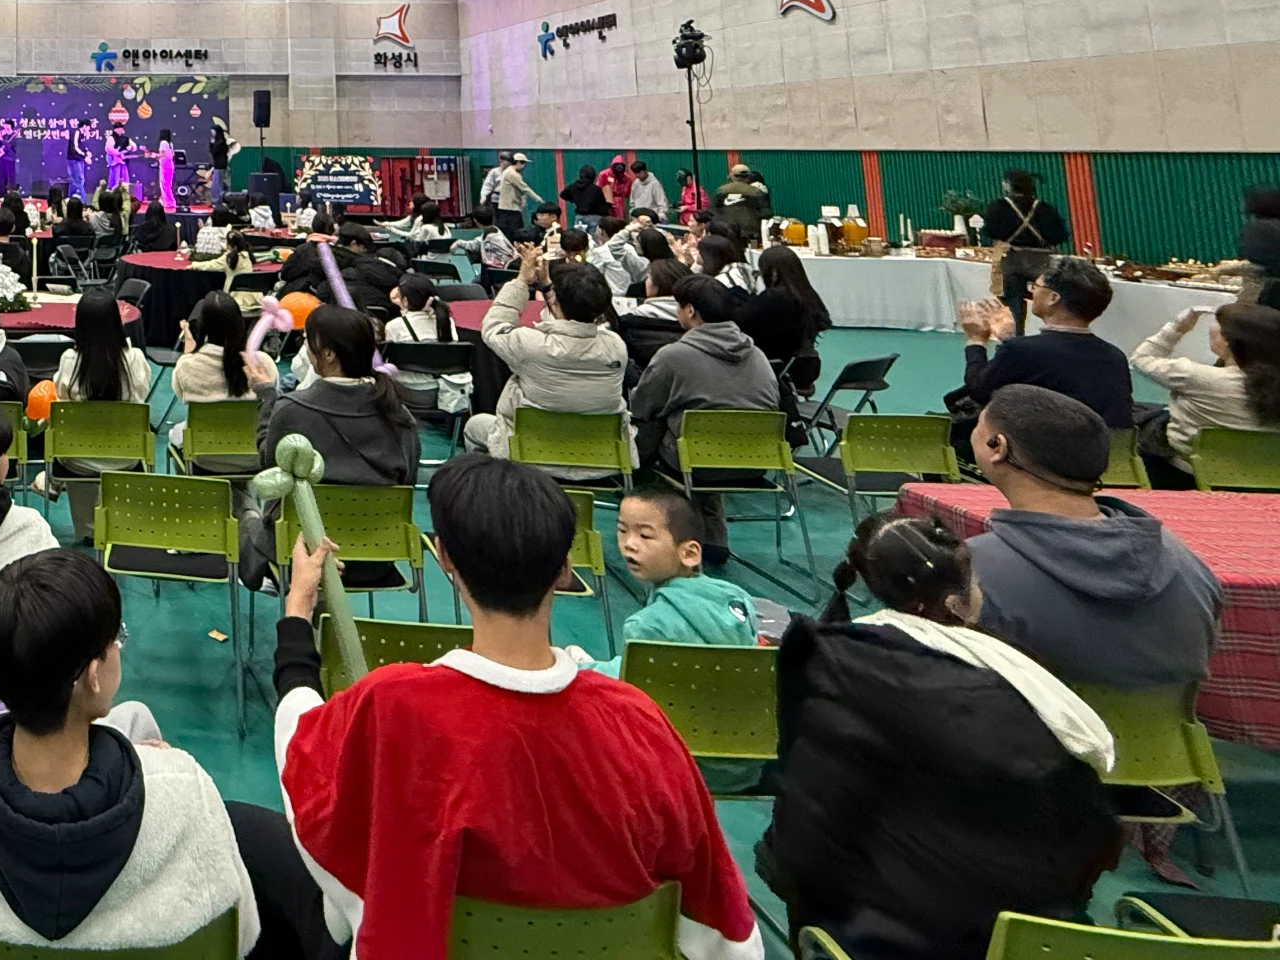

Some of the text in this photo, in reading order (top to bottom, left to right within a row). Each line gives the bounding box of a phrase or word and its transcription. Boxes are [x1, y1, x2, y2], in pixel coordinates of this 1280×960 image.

[374, 52, 417, 68] 화성시
[19, 118, 46, 128] 청소년
[69, 118, 99, 128] 한당
